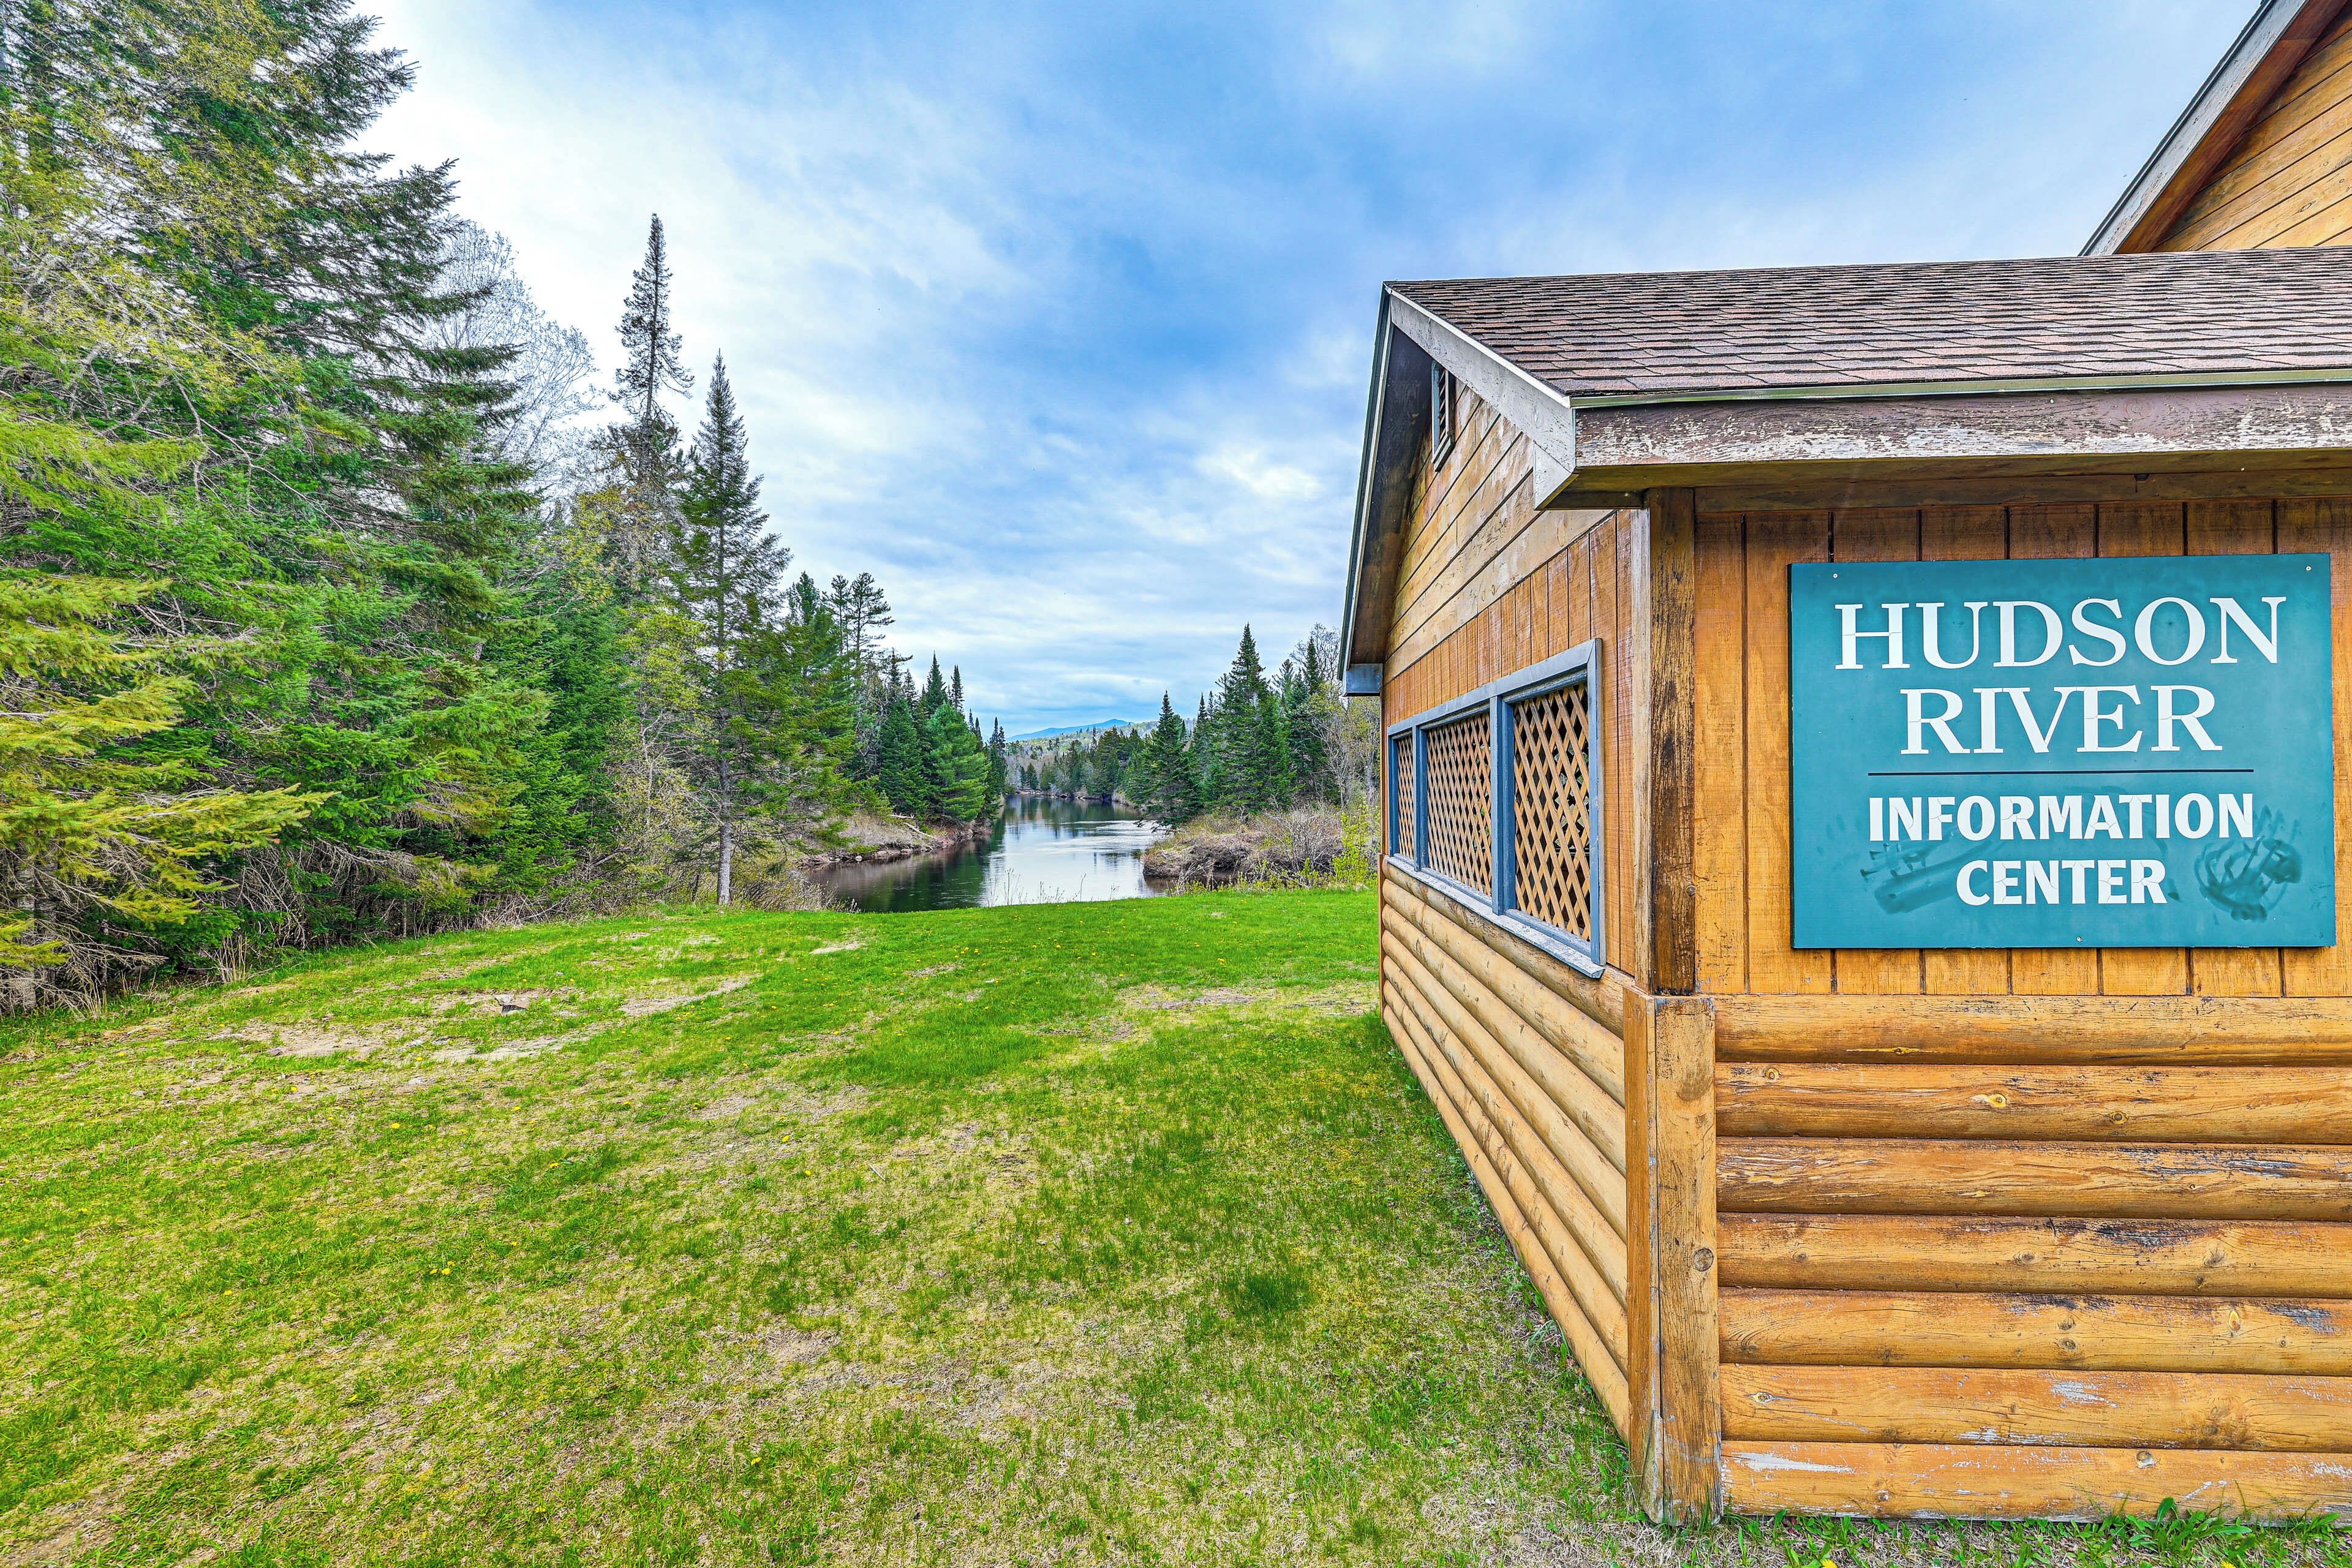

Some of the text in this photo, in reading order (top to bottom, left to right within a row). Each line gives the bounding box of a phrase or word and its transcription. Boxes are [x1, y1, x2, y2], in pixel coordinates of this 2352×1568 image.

[1835, 597, 2286, 669] HUDSON
[1900, 685, 2223, 754] RIVER
[1869, 793, 2253, 842] INFORMATION
[1956, 859, 2167, 906] CENTER
